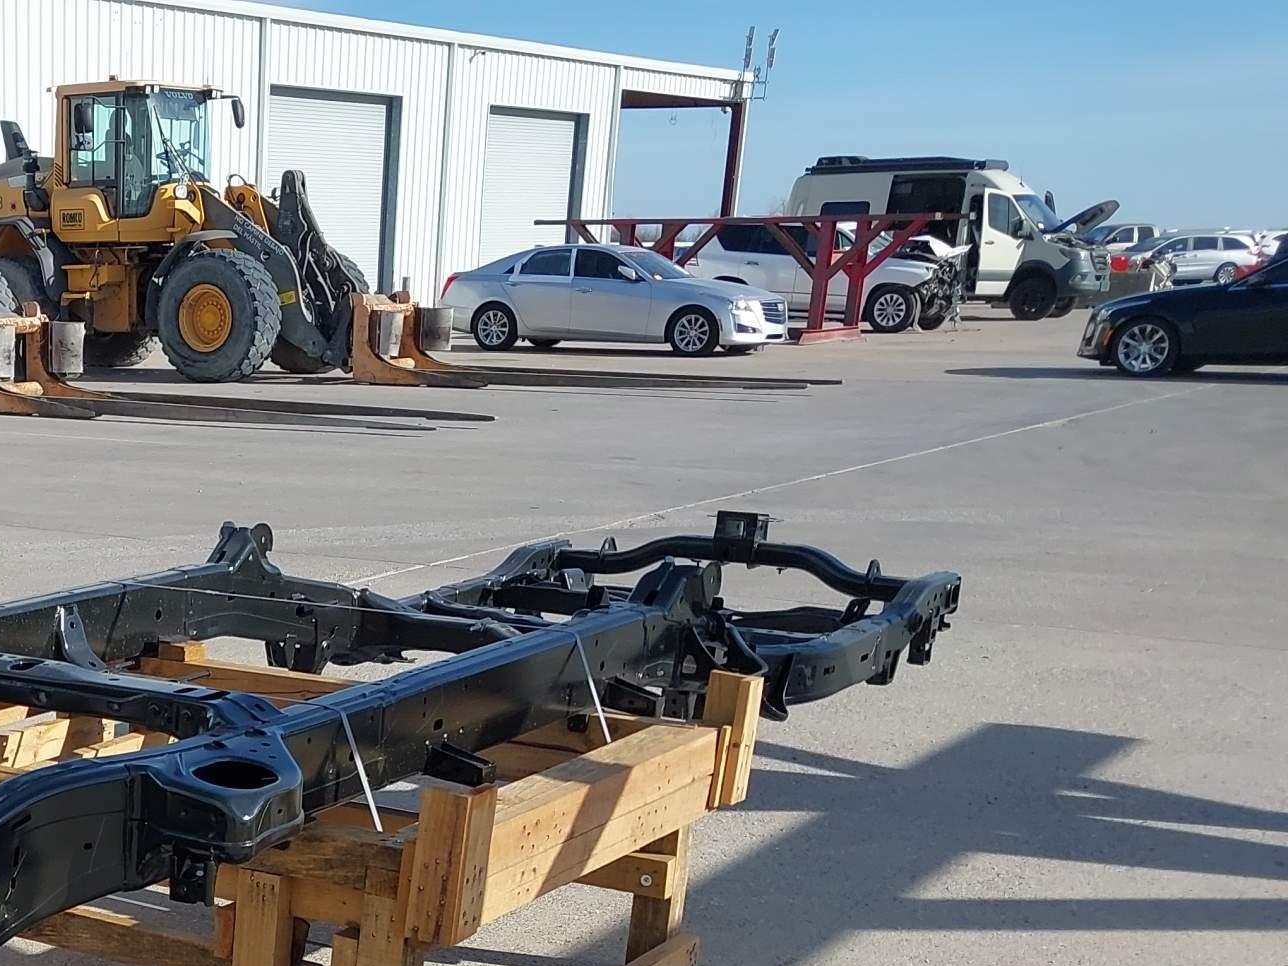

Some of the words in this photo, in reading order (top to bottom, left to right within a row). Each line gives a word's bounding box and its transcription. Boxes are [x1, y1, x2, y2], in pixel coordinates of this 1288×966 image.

[165, 91, 194, 99] VOLVO
[234, 215, 244, 224] NO
[233, 224, 243, 235] DEL
